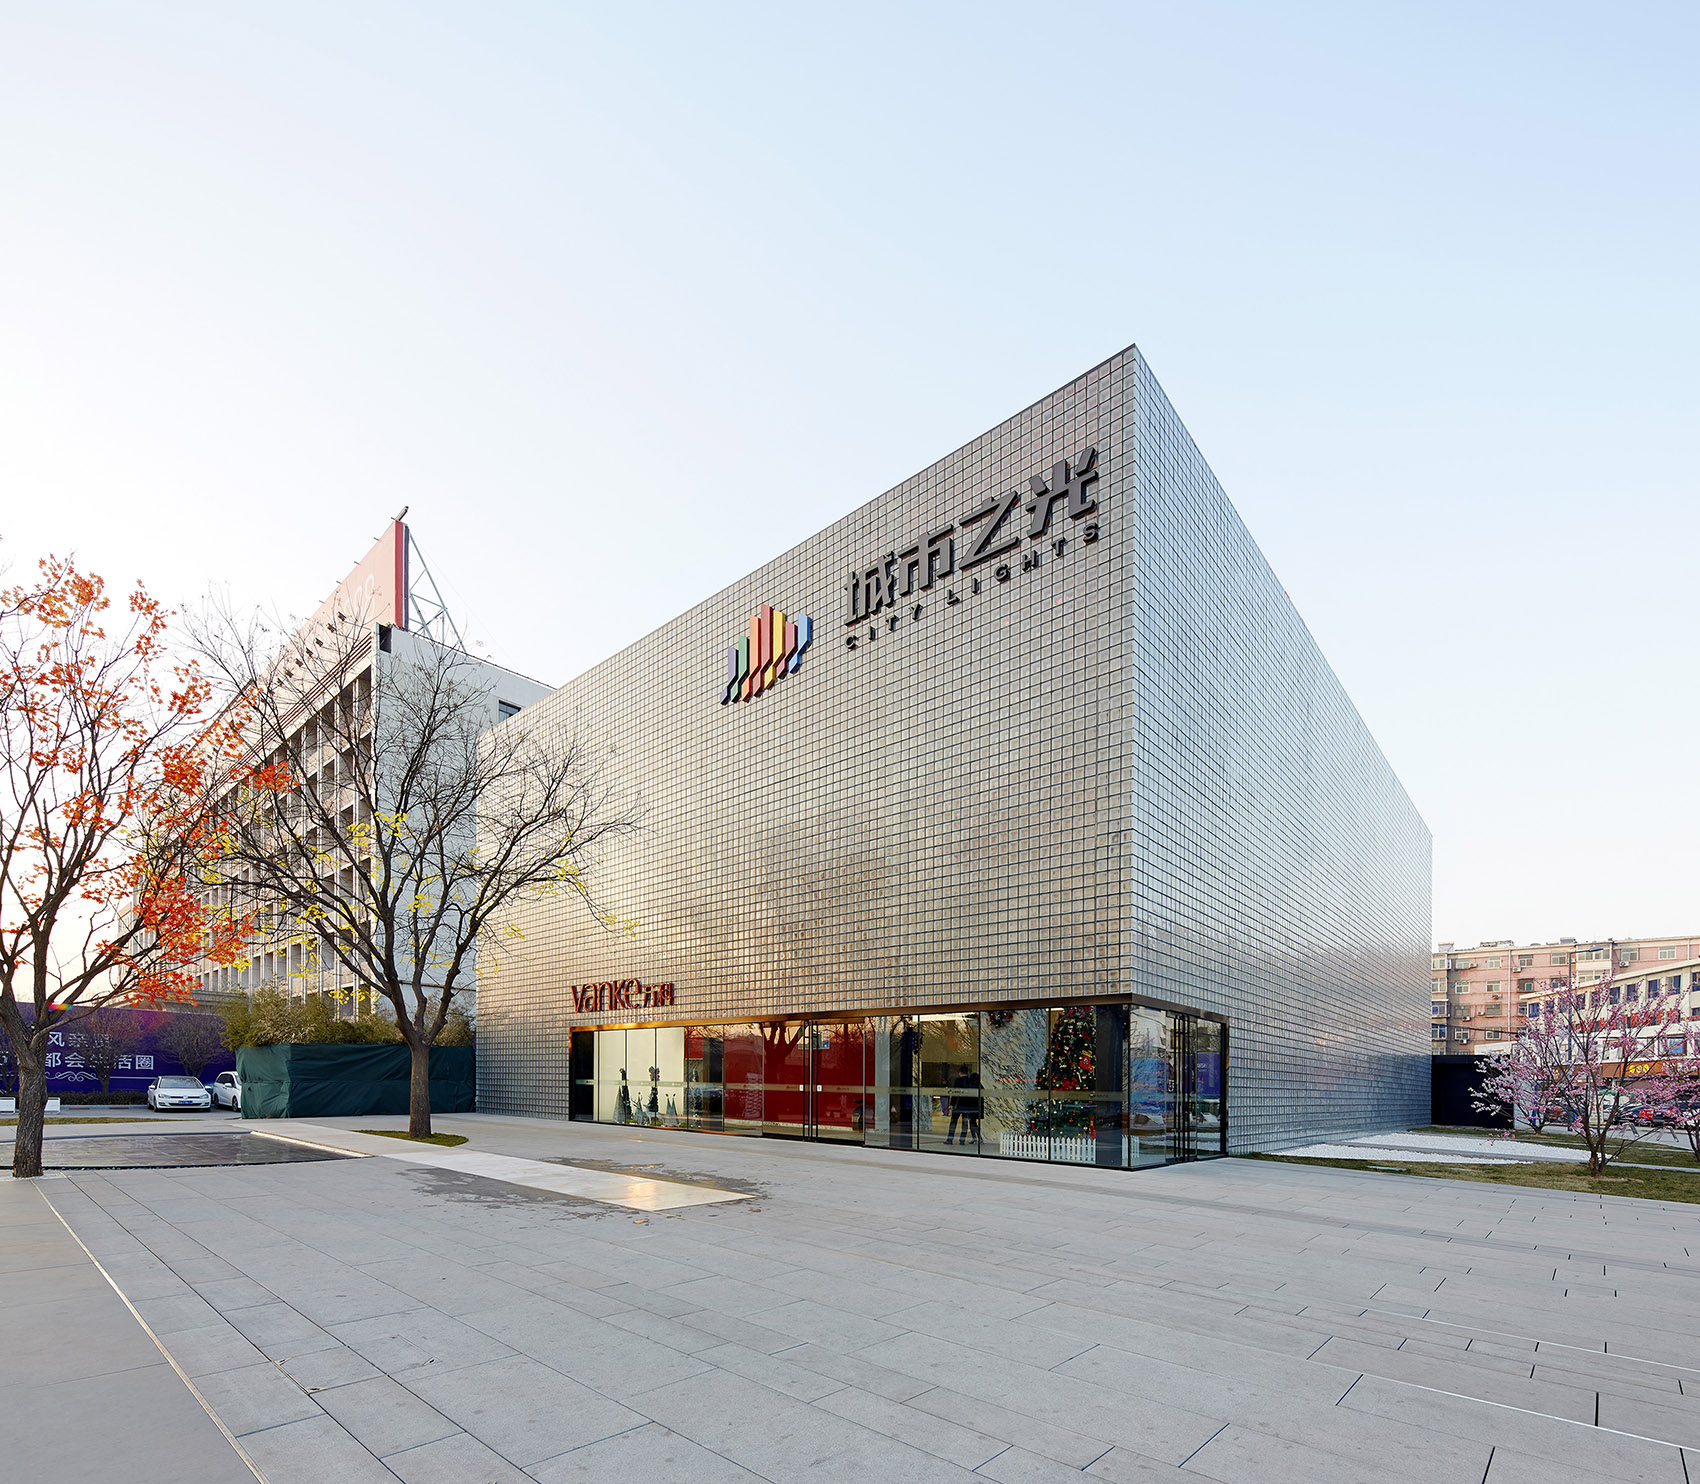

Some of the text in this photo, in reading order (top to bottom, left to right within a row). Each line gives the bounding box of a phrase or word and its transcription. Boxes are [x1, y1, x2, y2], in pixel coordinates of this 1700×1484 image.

[844, 447, 1098, 626] 城市之光
[845, 522, 1099, 650] CITY LIGHTS
